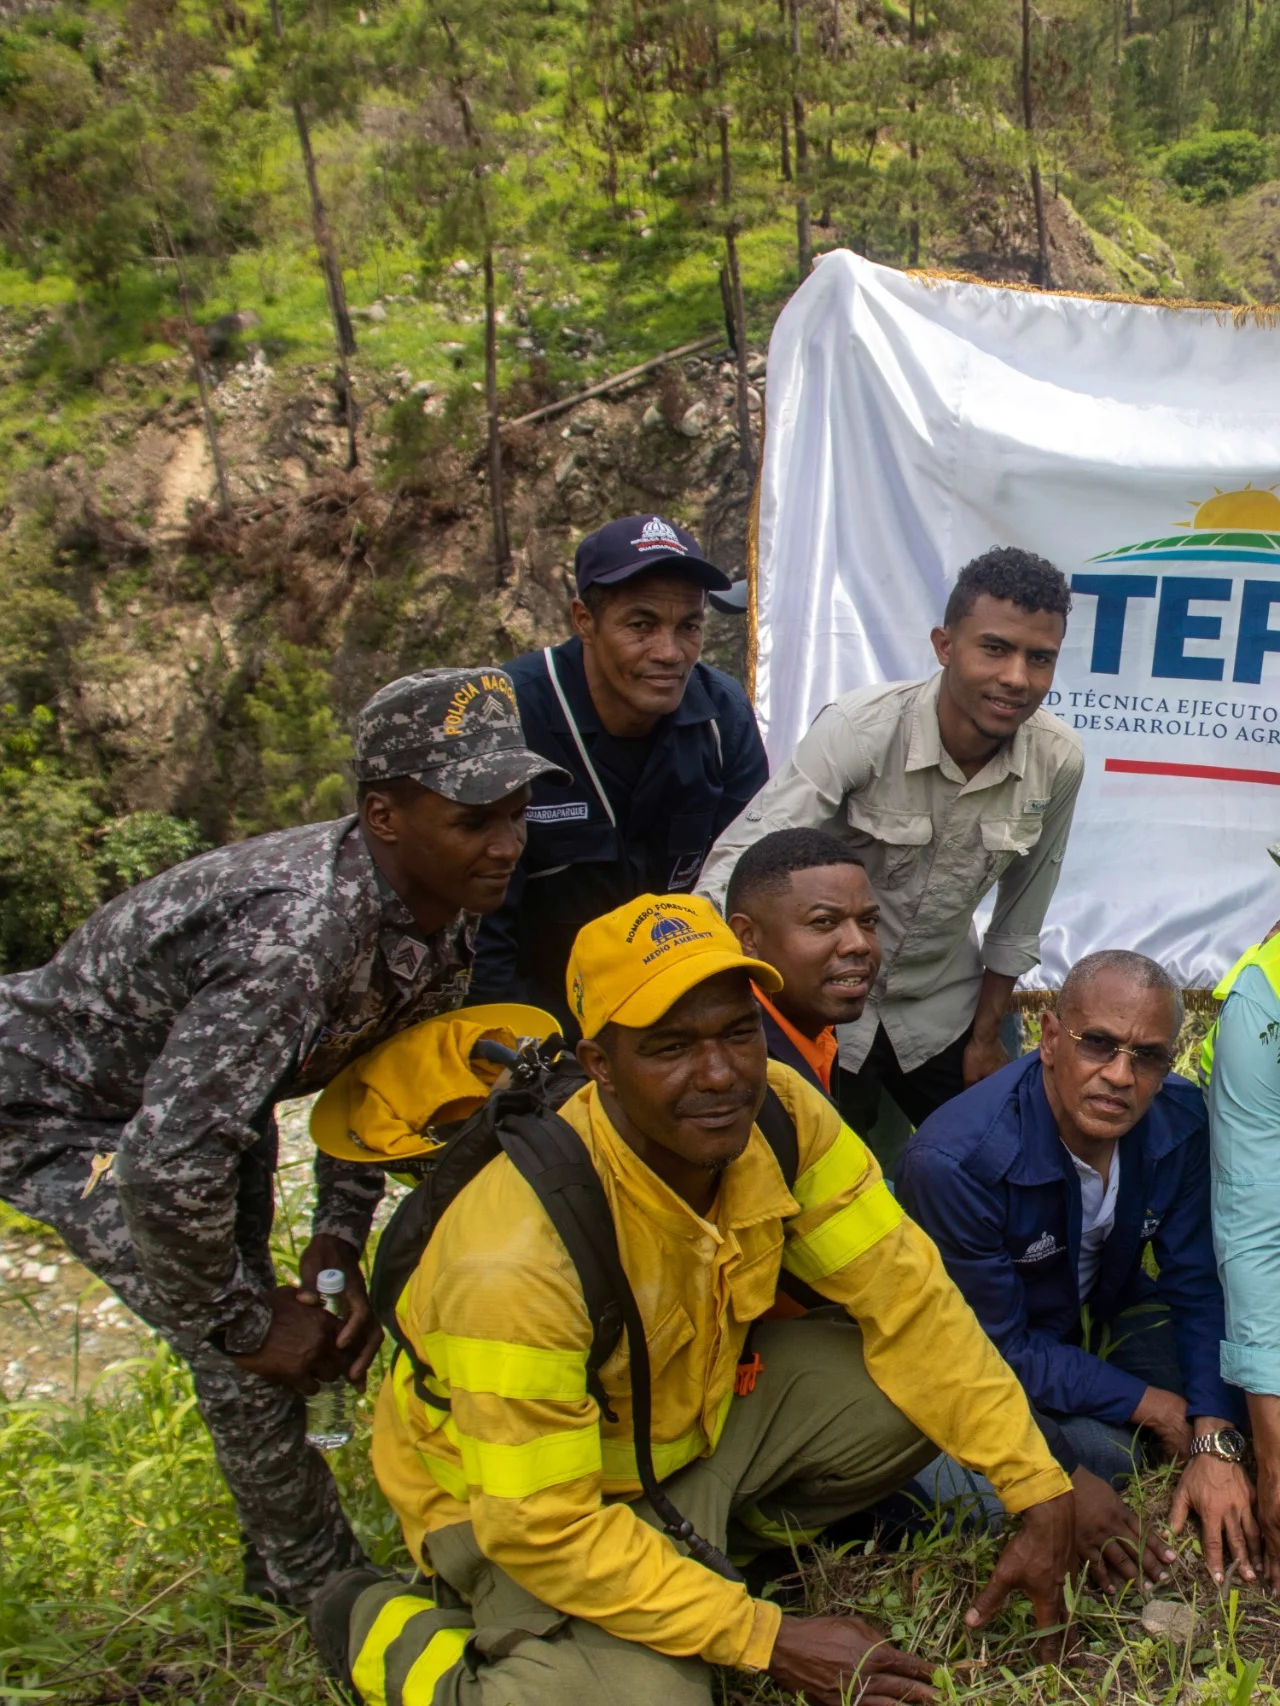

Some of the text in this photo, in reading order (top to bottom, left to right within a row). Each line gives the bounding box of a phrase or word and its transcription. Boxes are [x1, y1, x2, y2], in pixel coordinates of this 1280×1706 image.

[1069, 689, 1170, 713] TÉCNICA
[1073, 714, 1228, 739] DESARROLLO
[626, 907, 653, 944] BOMBERO
[642, 944, 671, 965] MEDIO
